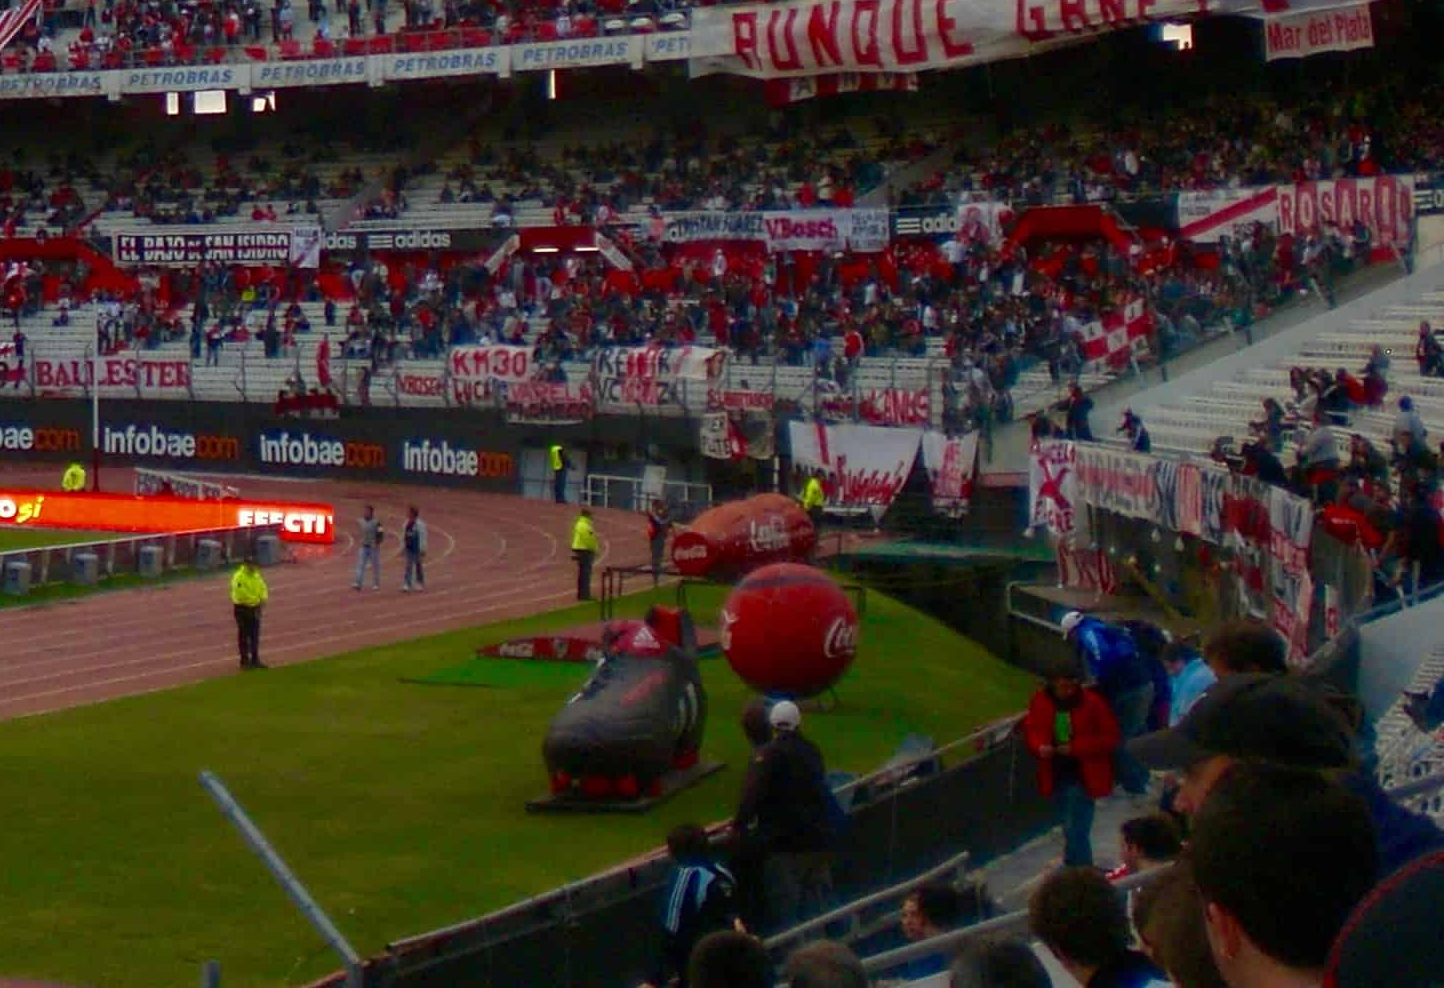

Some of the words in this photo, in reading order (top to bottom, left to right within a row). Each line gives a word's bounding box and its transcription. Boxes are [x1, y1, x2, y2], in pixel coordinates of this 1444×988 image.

[1268, 22, 1301, 52] Mar
[1308, 15, 1333, 46] del
[523, 41, 627, 62] PETROBRAS
[261, 62, 365, 81] PETROBRAS
[394, 53, 496, 72] PETROBRAS
[0, 75, 101, 92] PETROBRAS
[129, 69, 233, 87] PETROBRAS
[120, 235, 141, 261] EL
[144, 235, 185, 261] BAJO
[204, 234, 234, 260] SAN
[237, 233, 289, 260] ISIDRO
[394, 232, 451, 249] adidas
